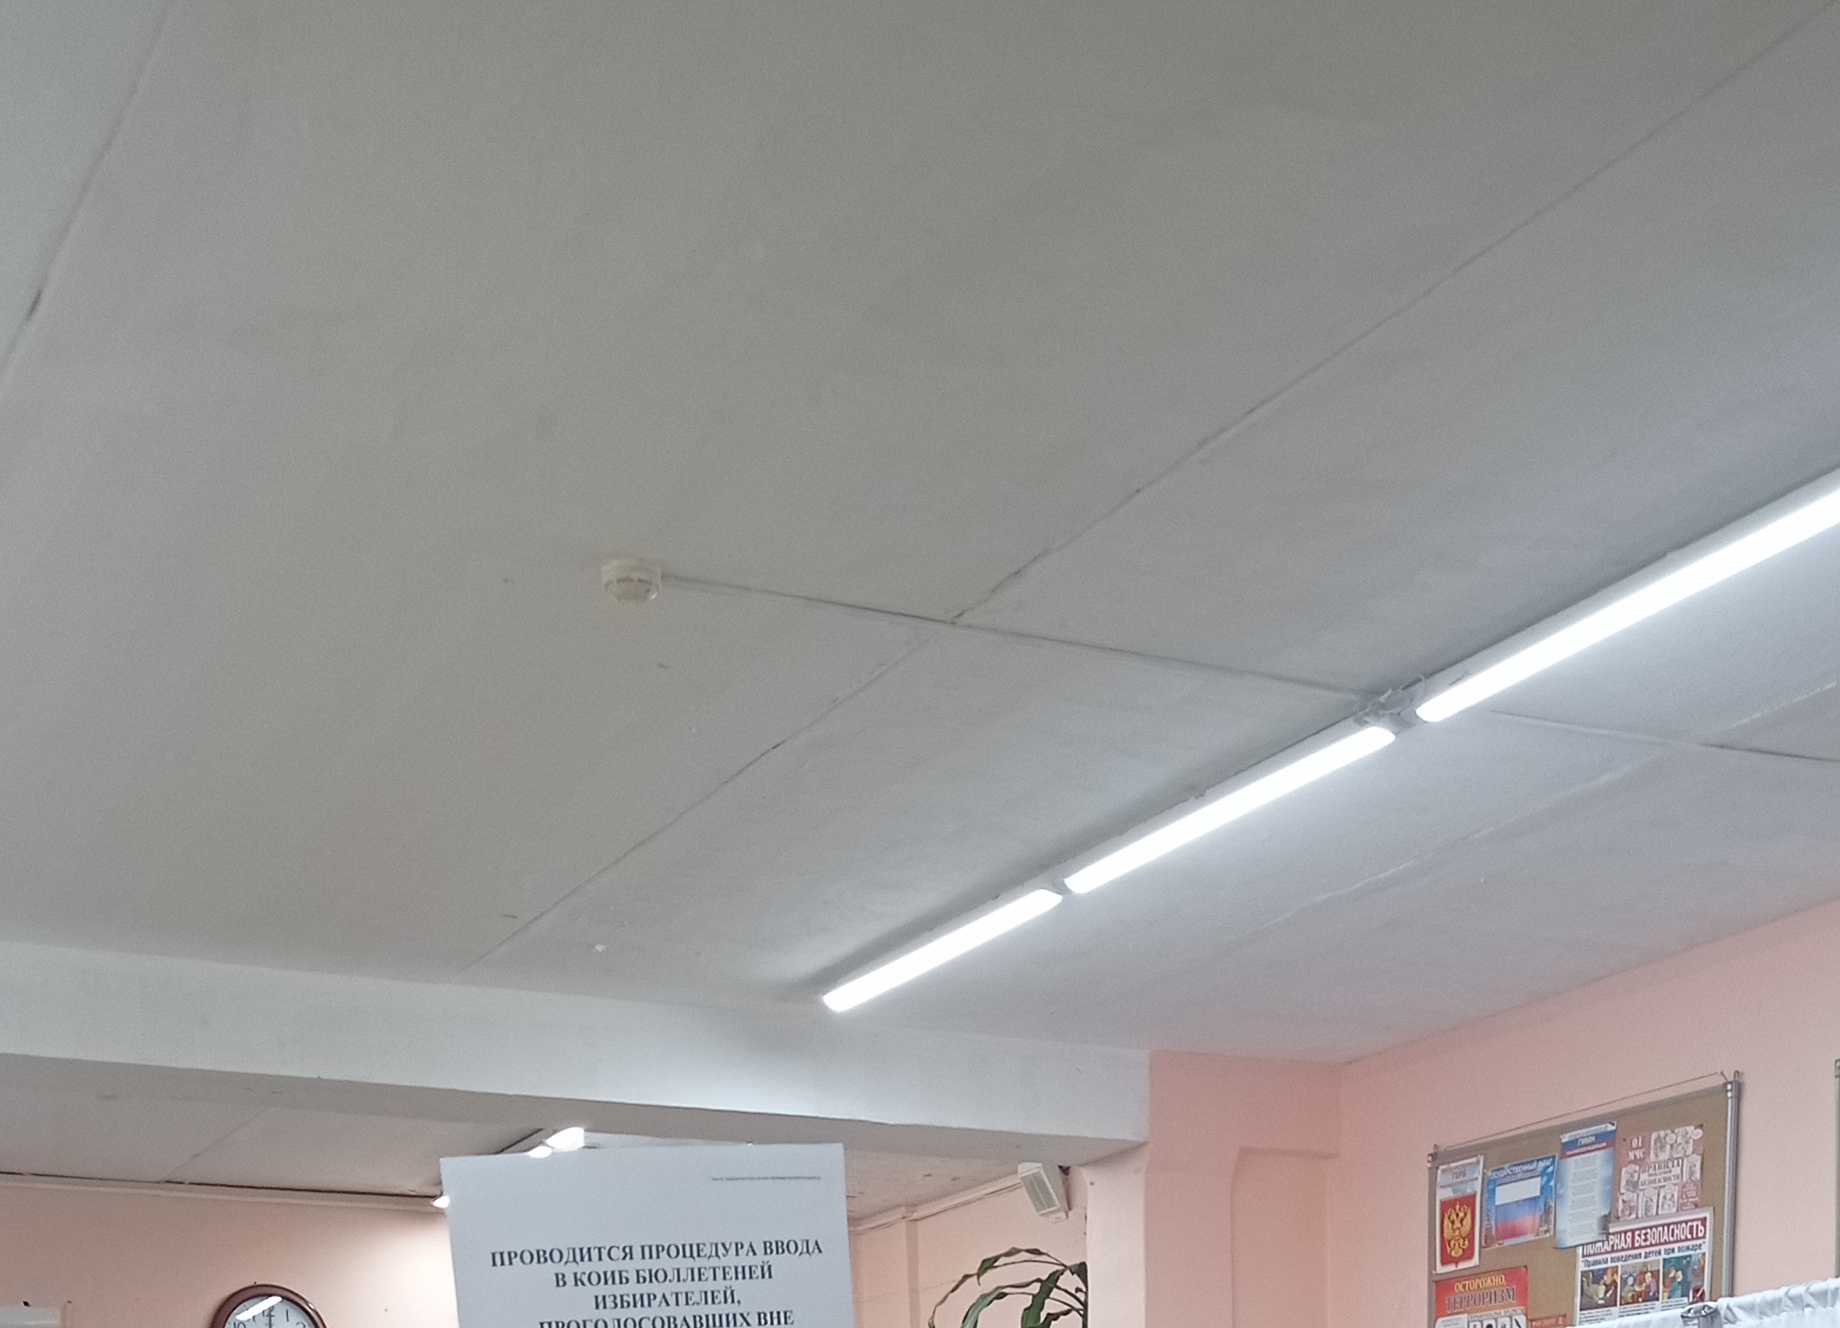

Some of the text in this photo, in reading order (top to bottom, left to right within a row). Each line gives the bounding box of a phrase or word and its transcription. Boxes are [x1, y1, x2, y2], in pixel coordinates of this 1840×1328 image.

[1634, 1221, 1706, 1248] БЕЗОПАСНОСТЬ
[490, 1239, 823, 1267] ПРОВОДИТСЯ ПРОЦЕДУРА ВВОДА
[554, 1261, 774, 1288] В КОИБ БЮЛЛЕТЕНЕЙ
[593, 1286, 742, 1310] ИЗБИРАТЕЛЕЙ,
[1446, 1287, 1517, 1312] ТЕРРОРИЗМ
[757, 1310, 795, 1327] ВНЕ
